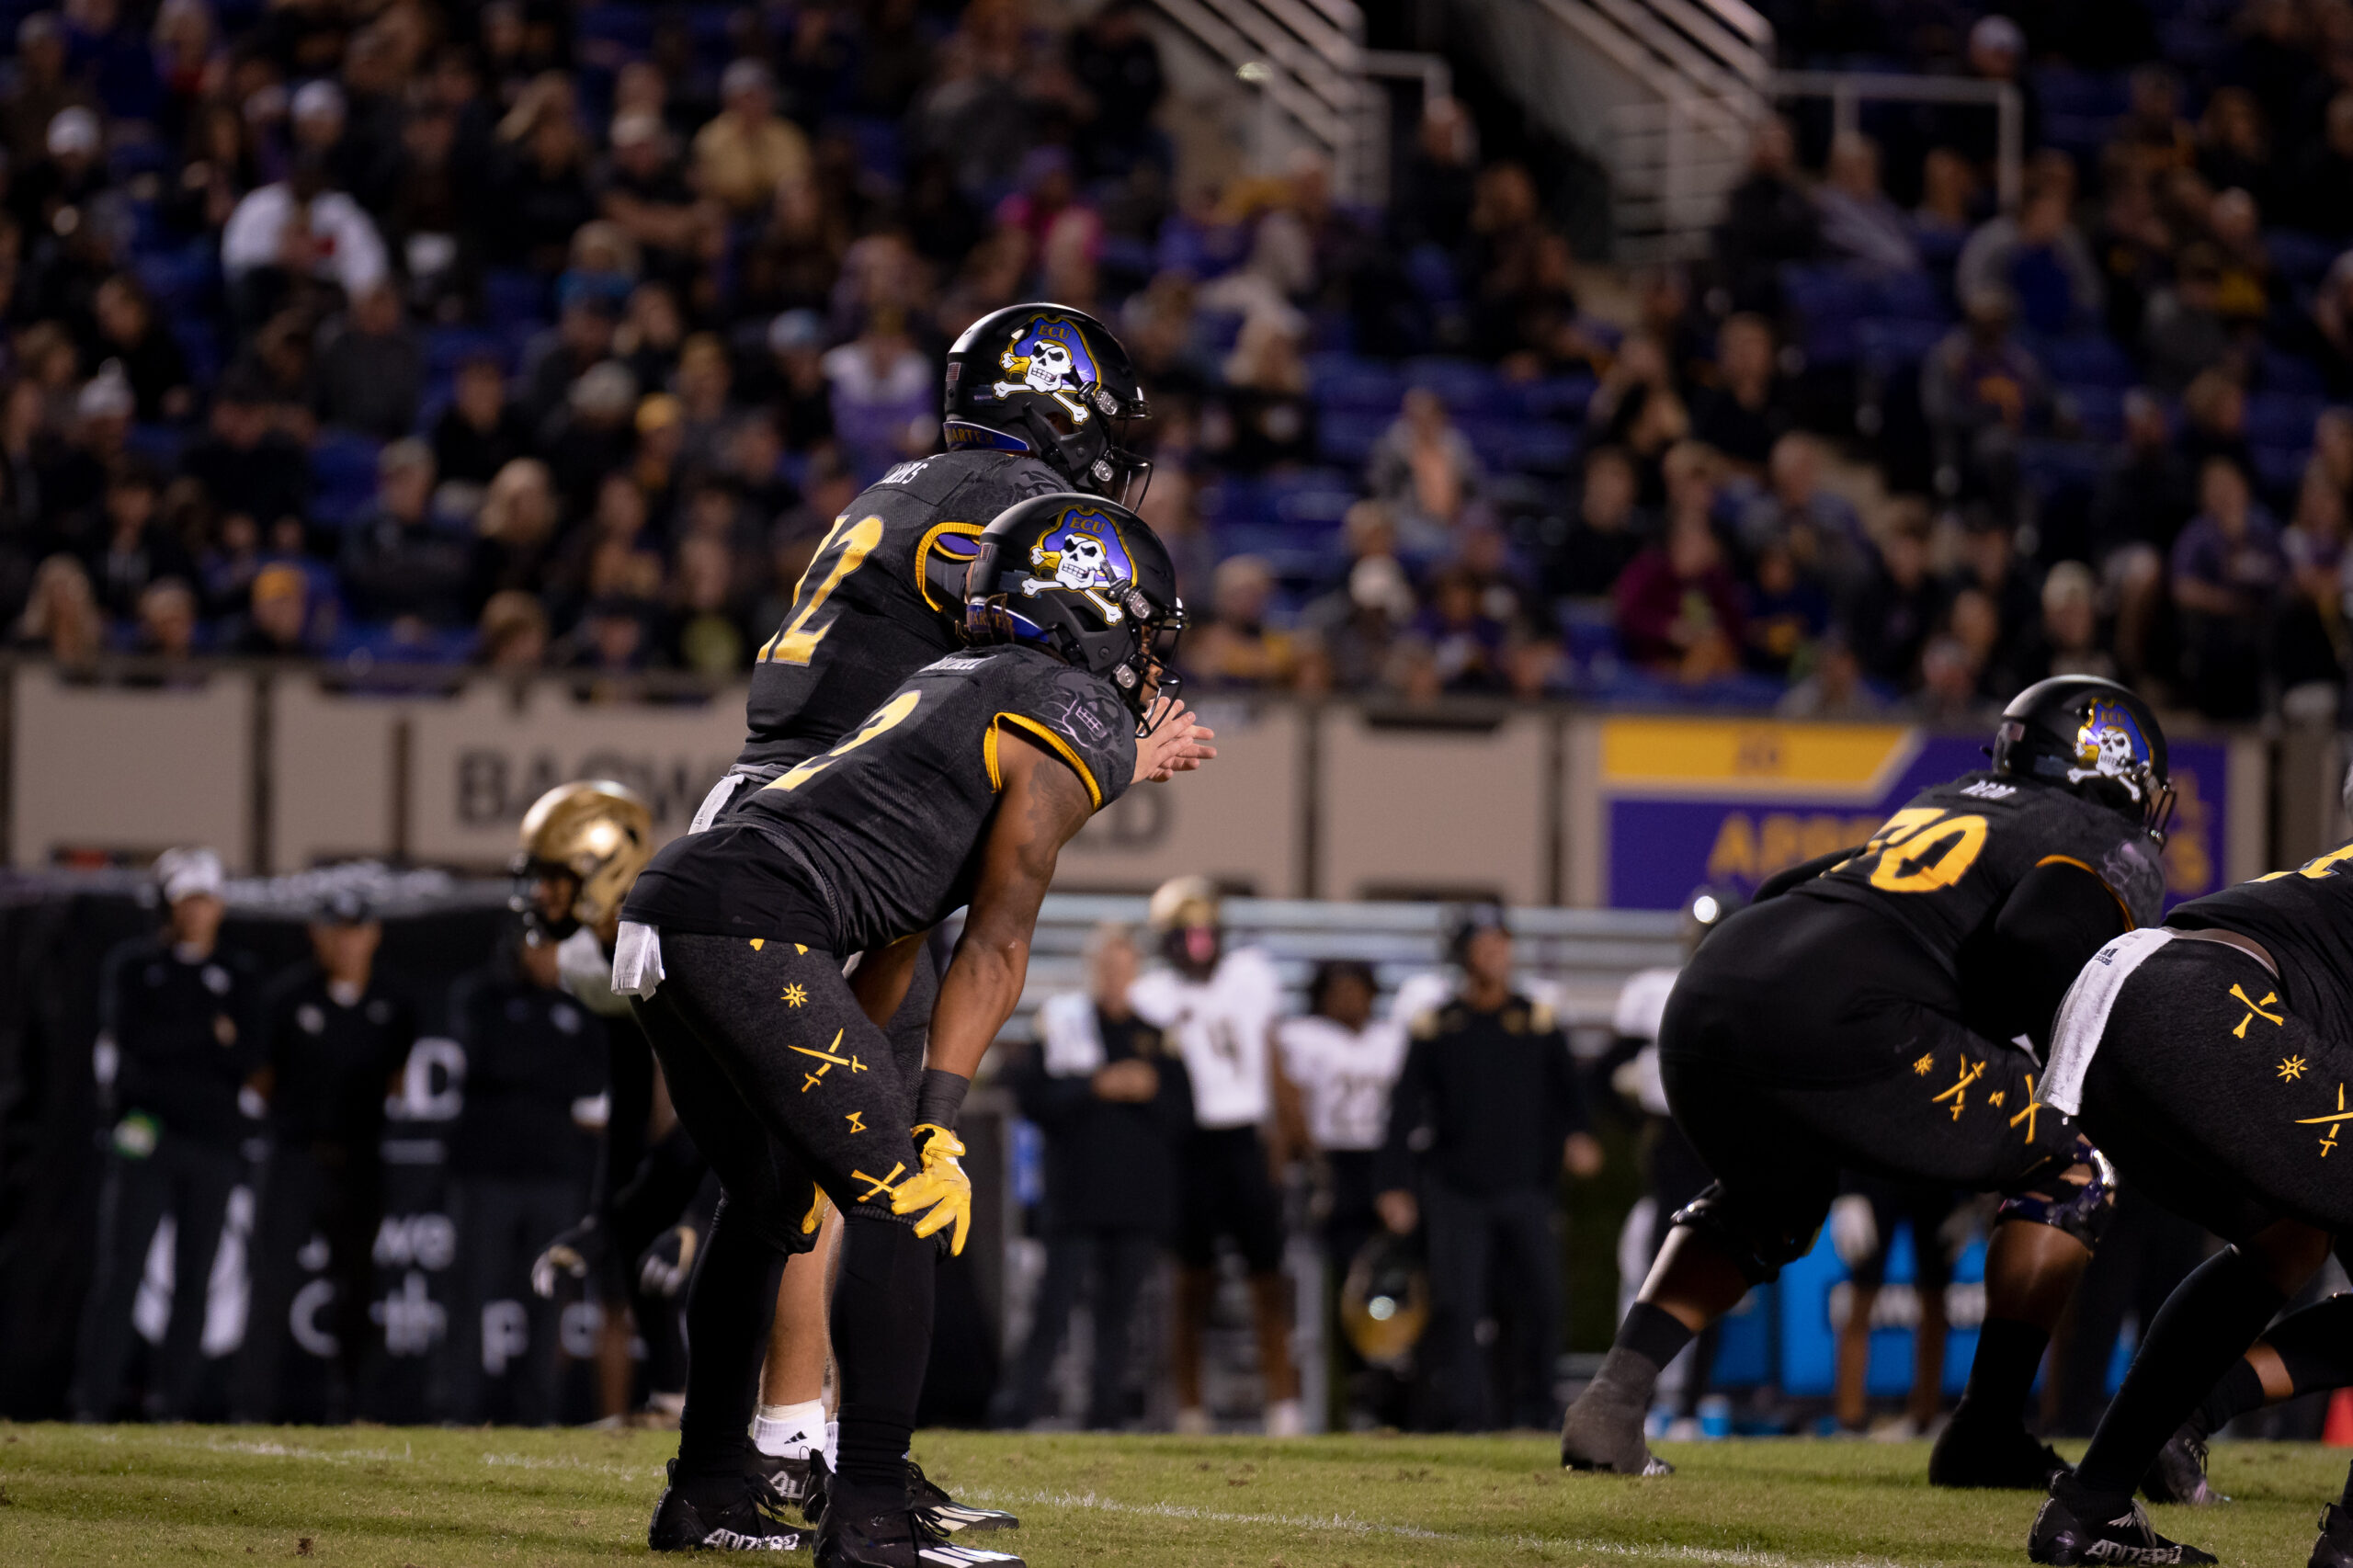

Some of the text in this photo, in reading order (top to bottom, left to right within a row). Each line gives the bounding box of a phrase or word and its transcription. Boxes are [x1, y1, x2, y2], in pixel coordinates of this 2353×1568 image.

[1037, 324, 1072, 339] ECU
[1068, 517, 1106, 533] ECU
[2100, 710, 2127, 723] ECU
[760, 690, 922, 793] 2
[1819, 807, 1988, 893] 70
